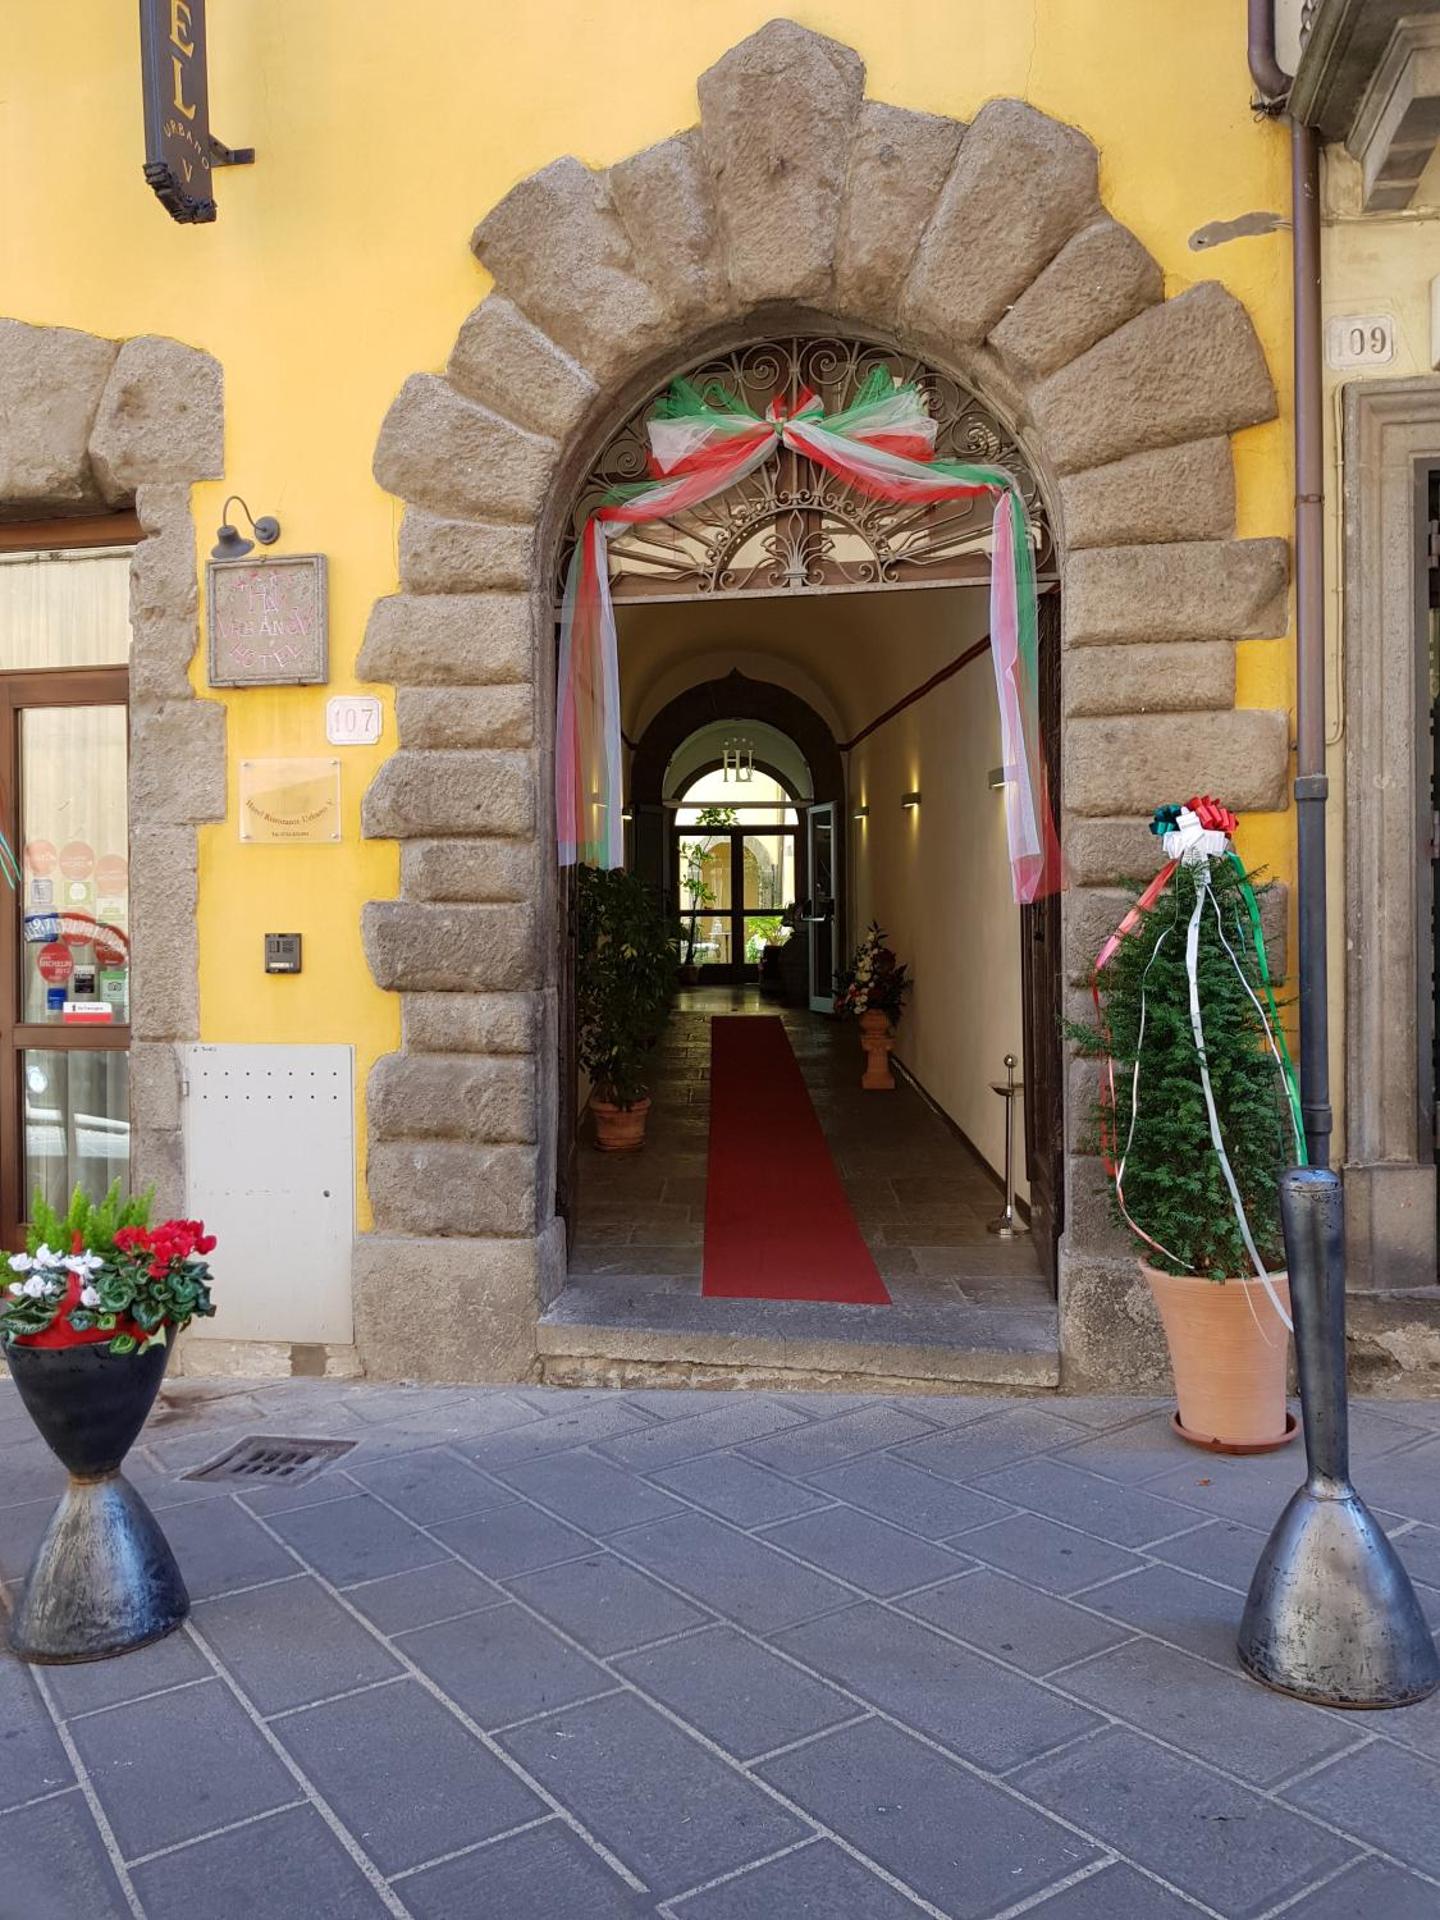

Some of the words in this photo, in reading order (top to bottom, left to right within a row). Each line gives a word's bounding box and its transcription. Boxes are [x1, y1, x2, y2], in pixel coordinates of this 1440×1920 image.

[163, 119, 210, 170] URBANO
[182, 157, 193, 183] V
[1337, 326, 1386, 356] 109
[229, 641, 304, 669] HOTEL
[335, 708, 373, 733] 107
